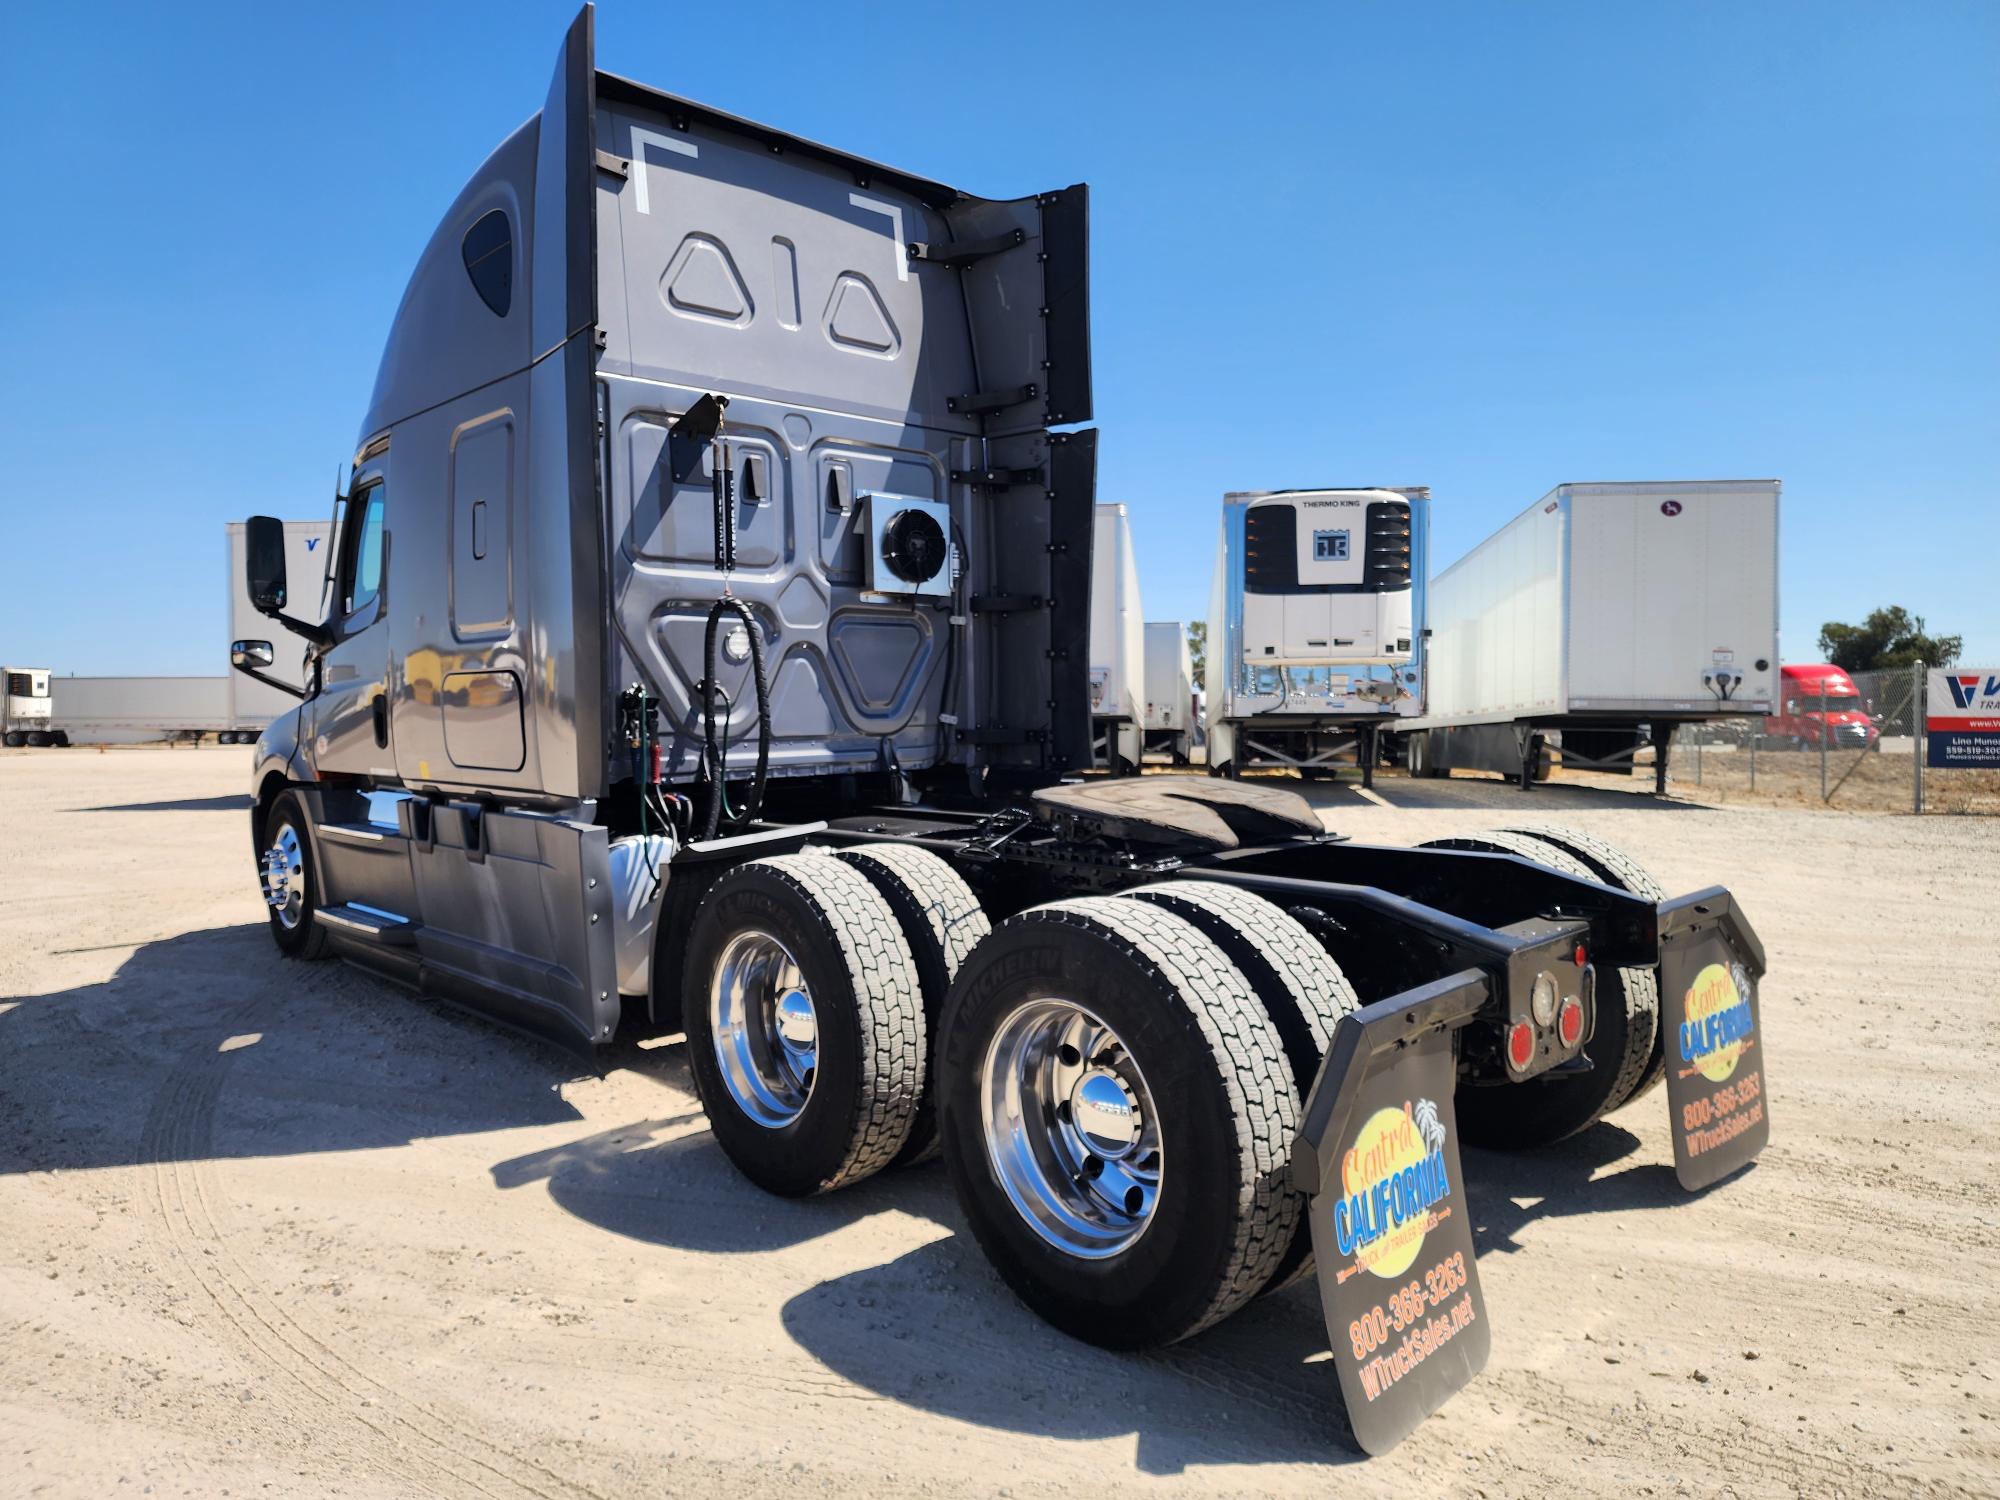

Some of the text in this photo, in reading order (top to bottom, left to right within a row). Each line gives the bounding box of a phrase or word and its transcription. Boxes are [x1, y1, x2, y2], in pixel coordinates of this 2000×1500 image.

[1969, 719, 2000, 728] www.V
[1342, 1100, 1414, 1198] Central
[1335, 1150, 1450, 1256] CALIFORNIA
[1350, 1251, 1468, 1361] 800-366-3263
[1358, 1291, 1476, 1402] WTruckSales.net
